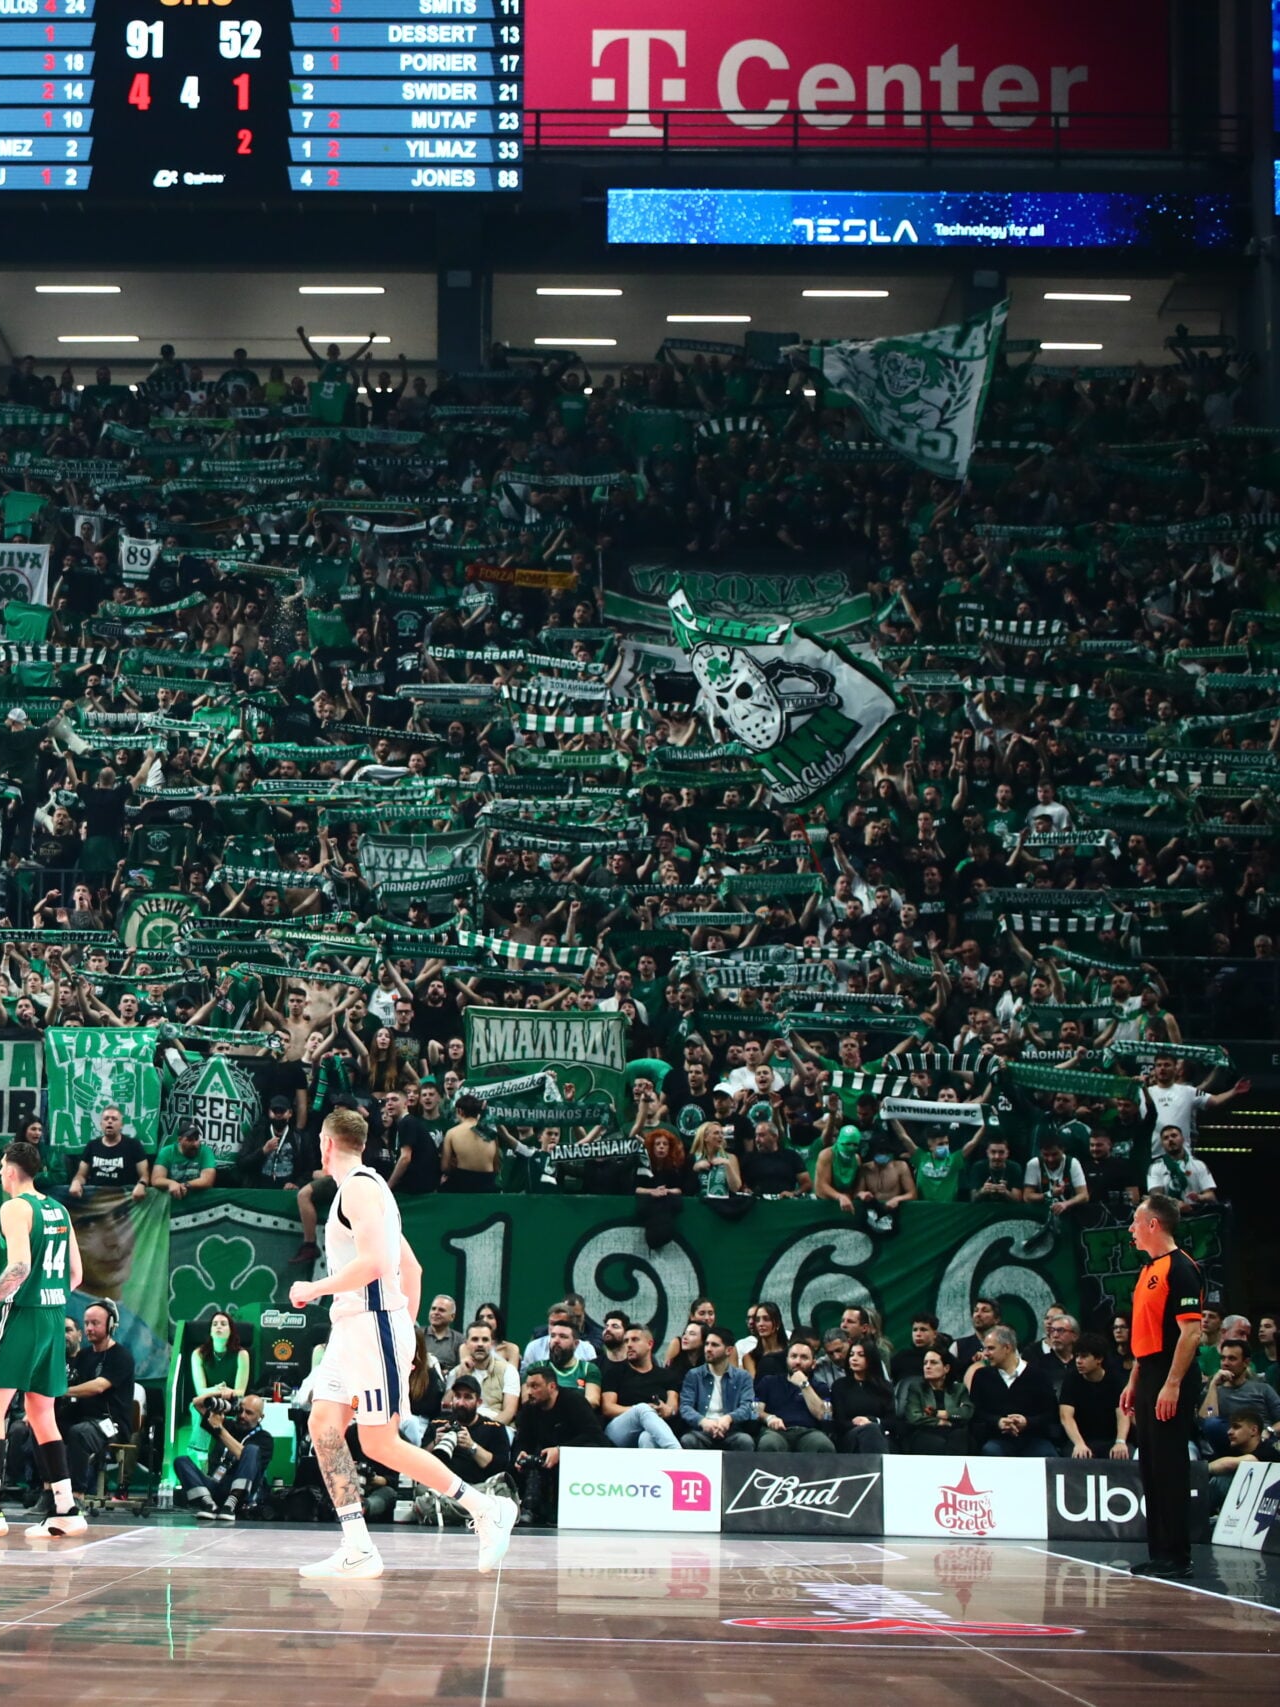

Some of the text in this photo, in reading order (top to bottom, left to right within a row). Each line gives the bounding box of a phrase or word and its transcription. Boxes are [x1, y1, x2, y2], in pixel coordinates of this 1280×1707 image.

[45, 26, 55, 42] 1
[125, 20, 164, 59] 91
[219, 20, 262, 59] 52
[331, 25, 520, 44] 1 DESSERT 13
[43, 54, 55, 71] 3
[64, 54, 84, 71] 18
[302, 54, 519, 72] 8 1 POIRIER 17
[42, 82, 54, 99] 2
[63, 83, 84, 100] 14
[128, 73, 151, 110] 4
[180, 76, 200, 109] 4
[232, 73, 251, 110] 1
[302, 83, 518, 101] 2 SWIDER 21
[591, 28, 1090, 138] T Center
[43, 111, 53, 128] 1
[63, 111, 83, 128] 10
[302, 112, 519, 130] 7 2 MUTAF 23
[66, 140, 77, 157] 2
[237, 129, 253, 154] 2
[302, 141, 519, 159] 1 2 YILMAZ 33
[42, 169, 51, 185] 1
[66, 169, 77, 186] 2
[300, 170, 518, 188] 4 2 JONES 88
[793, 218, 1044, 243] TESLA Technology for all
[126, 545, 151, 566] 89
[478, 568, 515, 582] FORZA
[427, 646, 525, 661] AGIA BARBARA
[801, 750, 847, 789] Club
[471, 1016, 623, 1072] ΑΜΑΛΙΑΔΑ
[174, 1094, 257, 1122] GREEN
[487, 1105, 582, 1120] PANATHINAIKOS
[42, 1240, 67, 1279] 44
[364, 1388, 383, 1412] 11
[568, 1481, 662, 1499] COSMOTE
[752, 1471, 841, 1507] Bud
[941, 1489, 986, 1513] Hans
